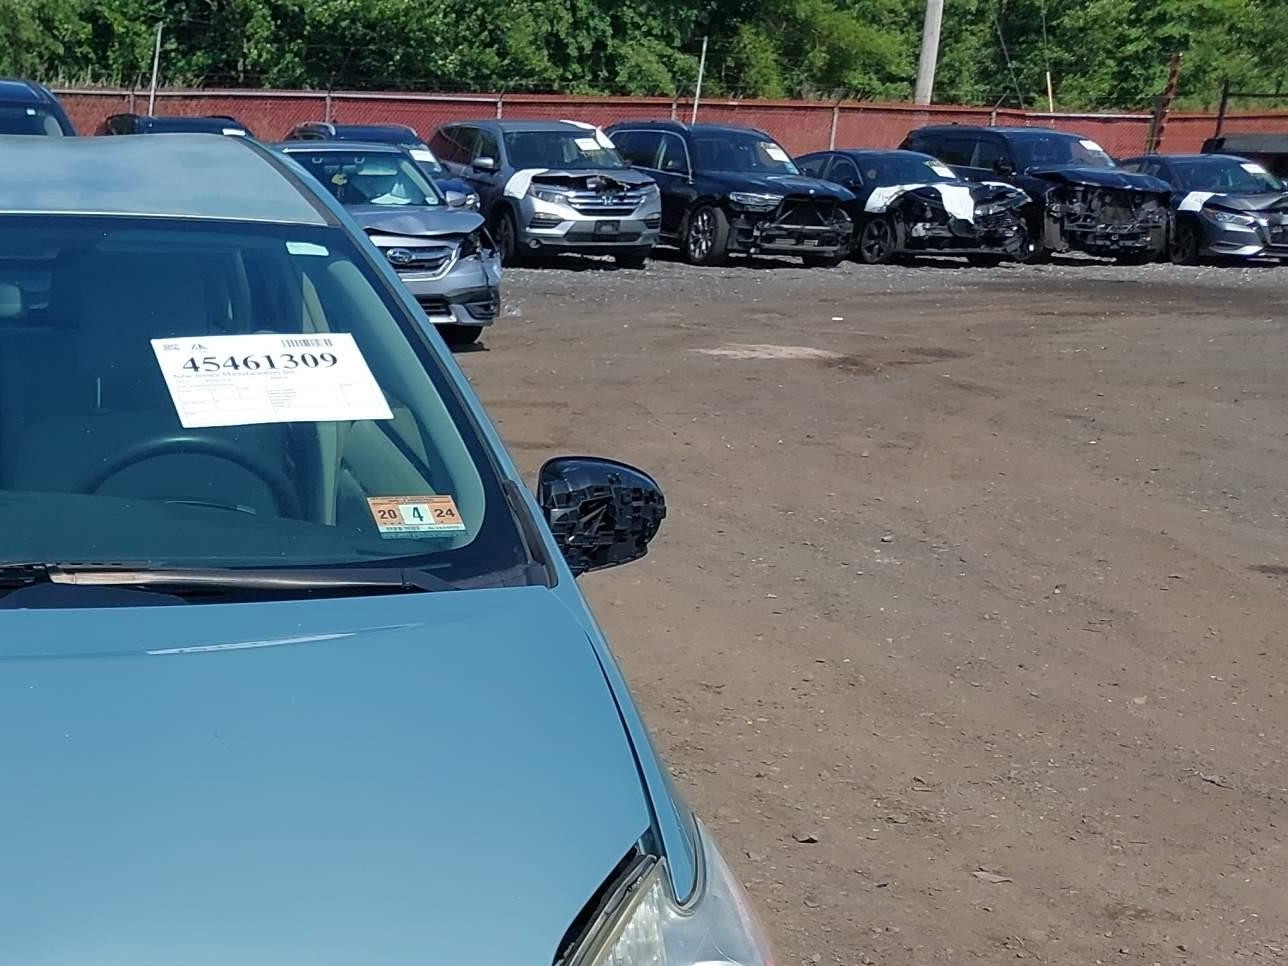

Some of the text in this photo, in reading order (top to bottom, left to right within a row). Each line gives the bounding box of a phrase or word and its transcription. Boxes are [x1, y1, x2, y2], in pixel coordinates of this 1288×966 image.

[183, 352, 338, 372] 45461309
[378, 507, 455, 521] 20 4 24
